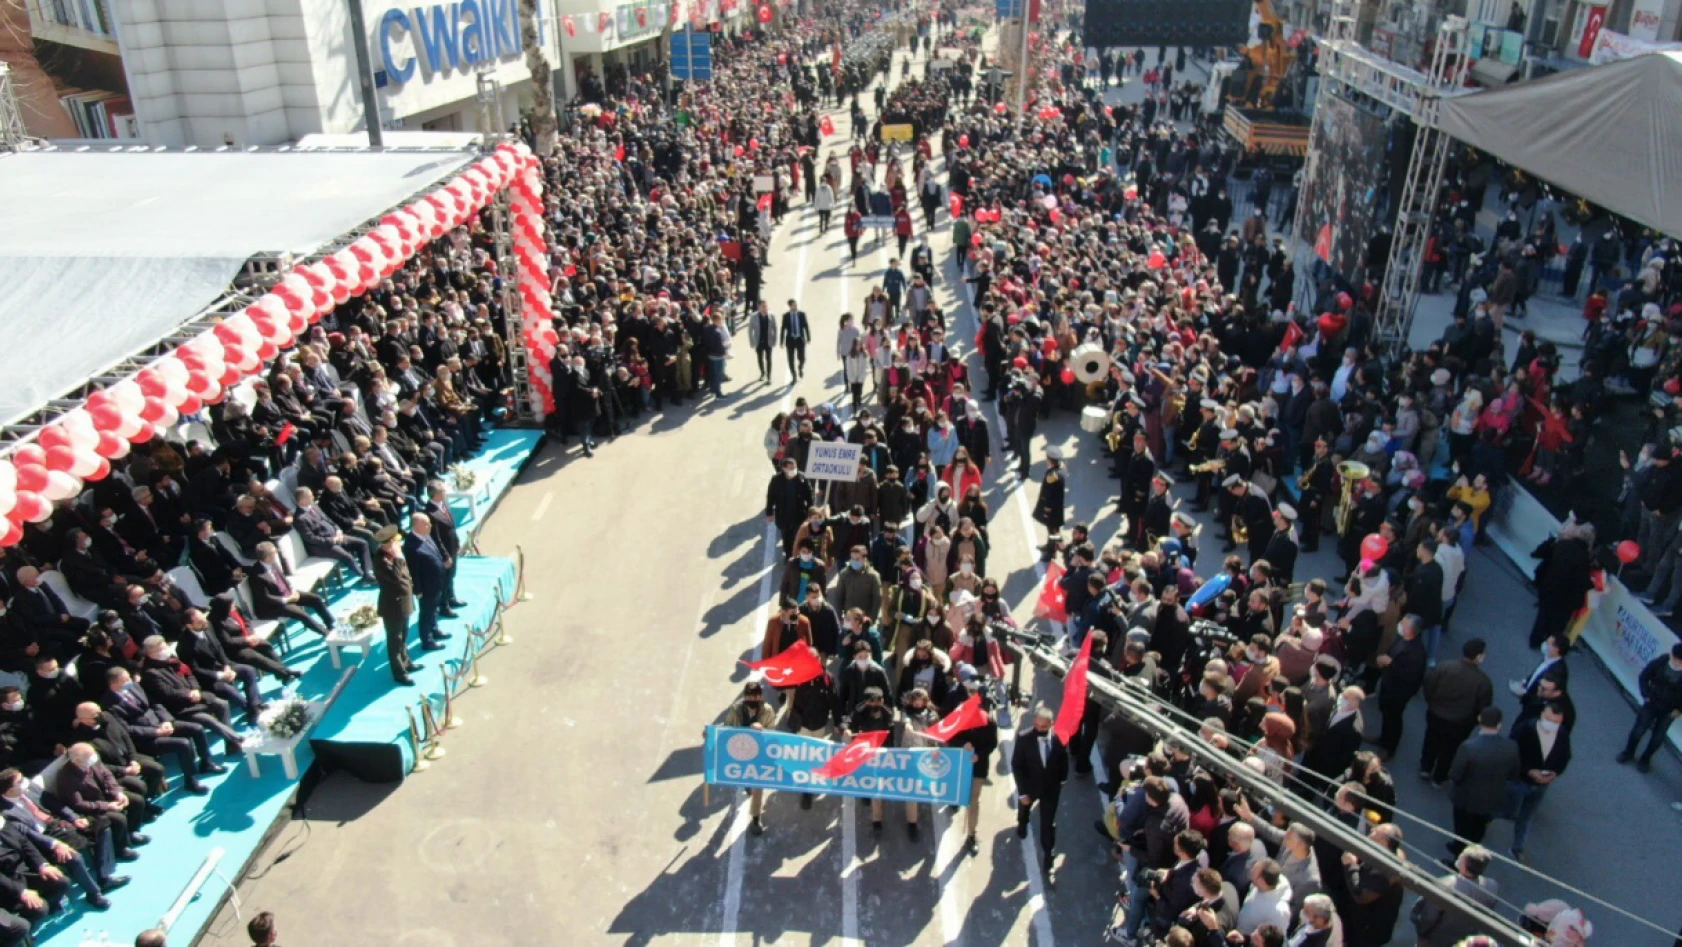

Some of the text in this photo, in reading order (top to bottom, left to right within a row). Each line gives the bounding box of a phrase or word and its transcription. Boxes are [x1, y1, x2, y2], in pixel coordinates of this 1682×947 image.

[815, 447, 856, 460] YUNUS EMRE
[811, 463, 851, 476] ORTAOKULU
